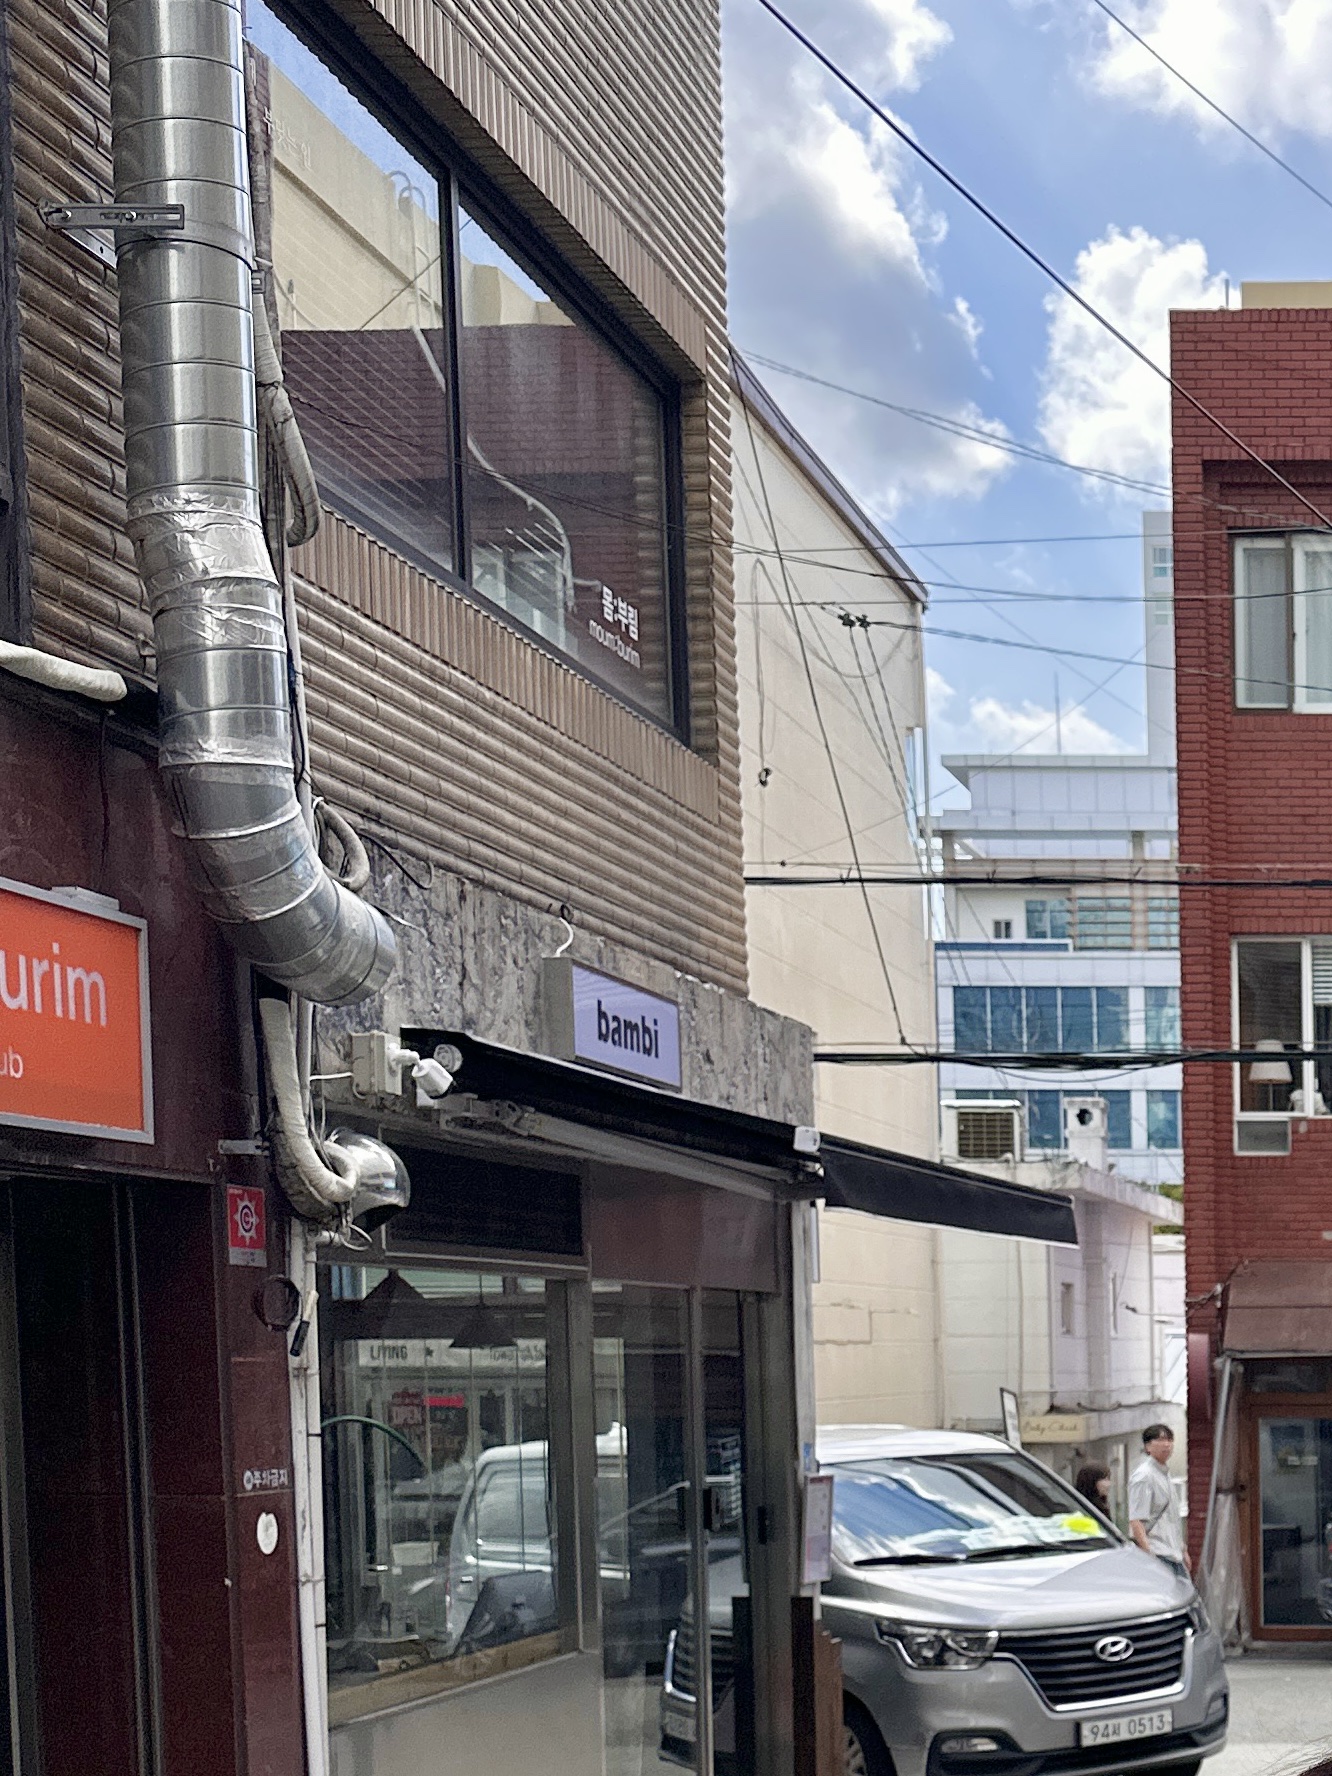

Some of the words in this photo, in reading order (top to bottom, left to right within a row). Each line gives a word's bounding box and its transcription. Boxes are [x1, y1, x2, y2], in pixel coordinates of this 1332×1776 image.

[0, 942, 107, 1027] urim
[597, 999, 659, 1059] bambi
[1127, 1714, 1165, 1736] 0513
